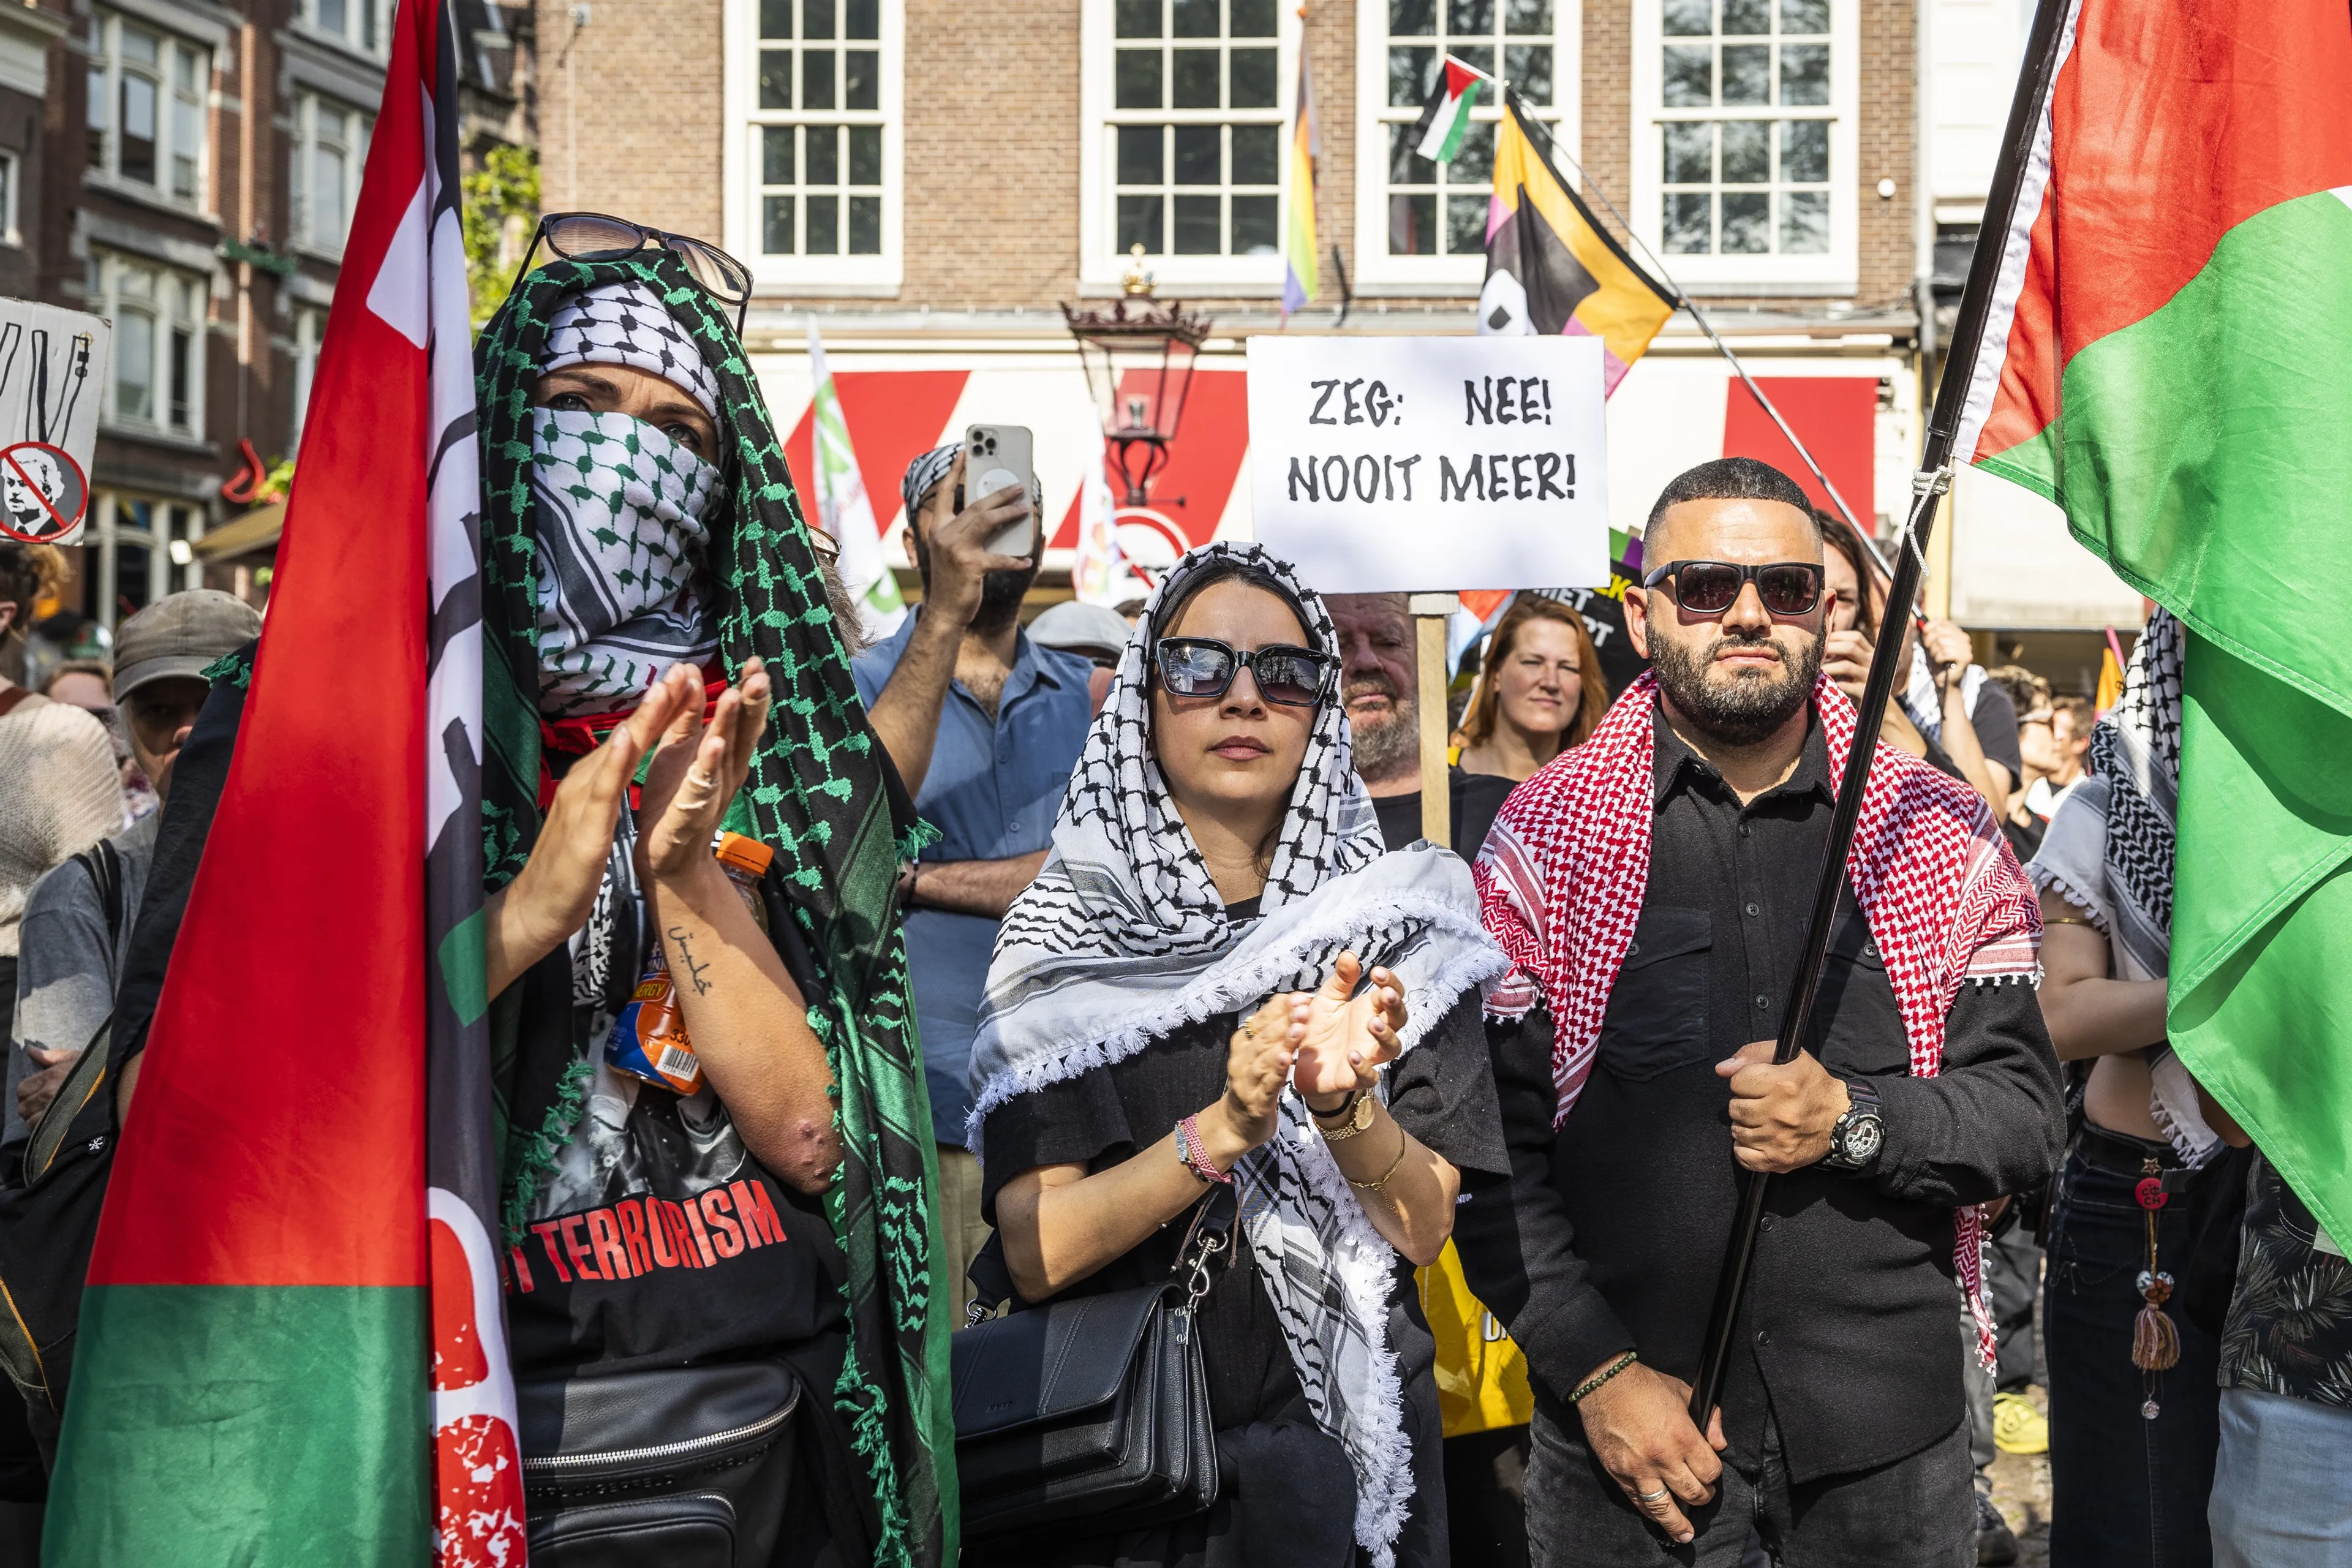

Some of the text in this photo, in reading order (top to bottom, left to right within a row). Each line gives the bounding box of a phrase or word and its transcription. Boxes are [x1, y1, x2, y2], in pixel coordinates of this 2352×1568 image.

[1309, 375, 1551, 428] ZEG: NEE!
[1288, 452, 1575, 503] NOOIT MEER!
[530, 1179, 787, 1283] TERRORISM
